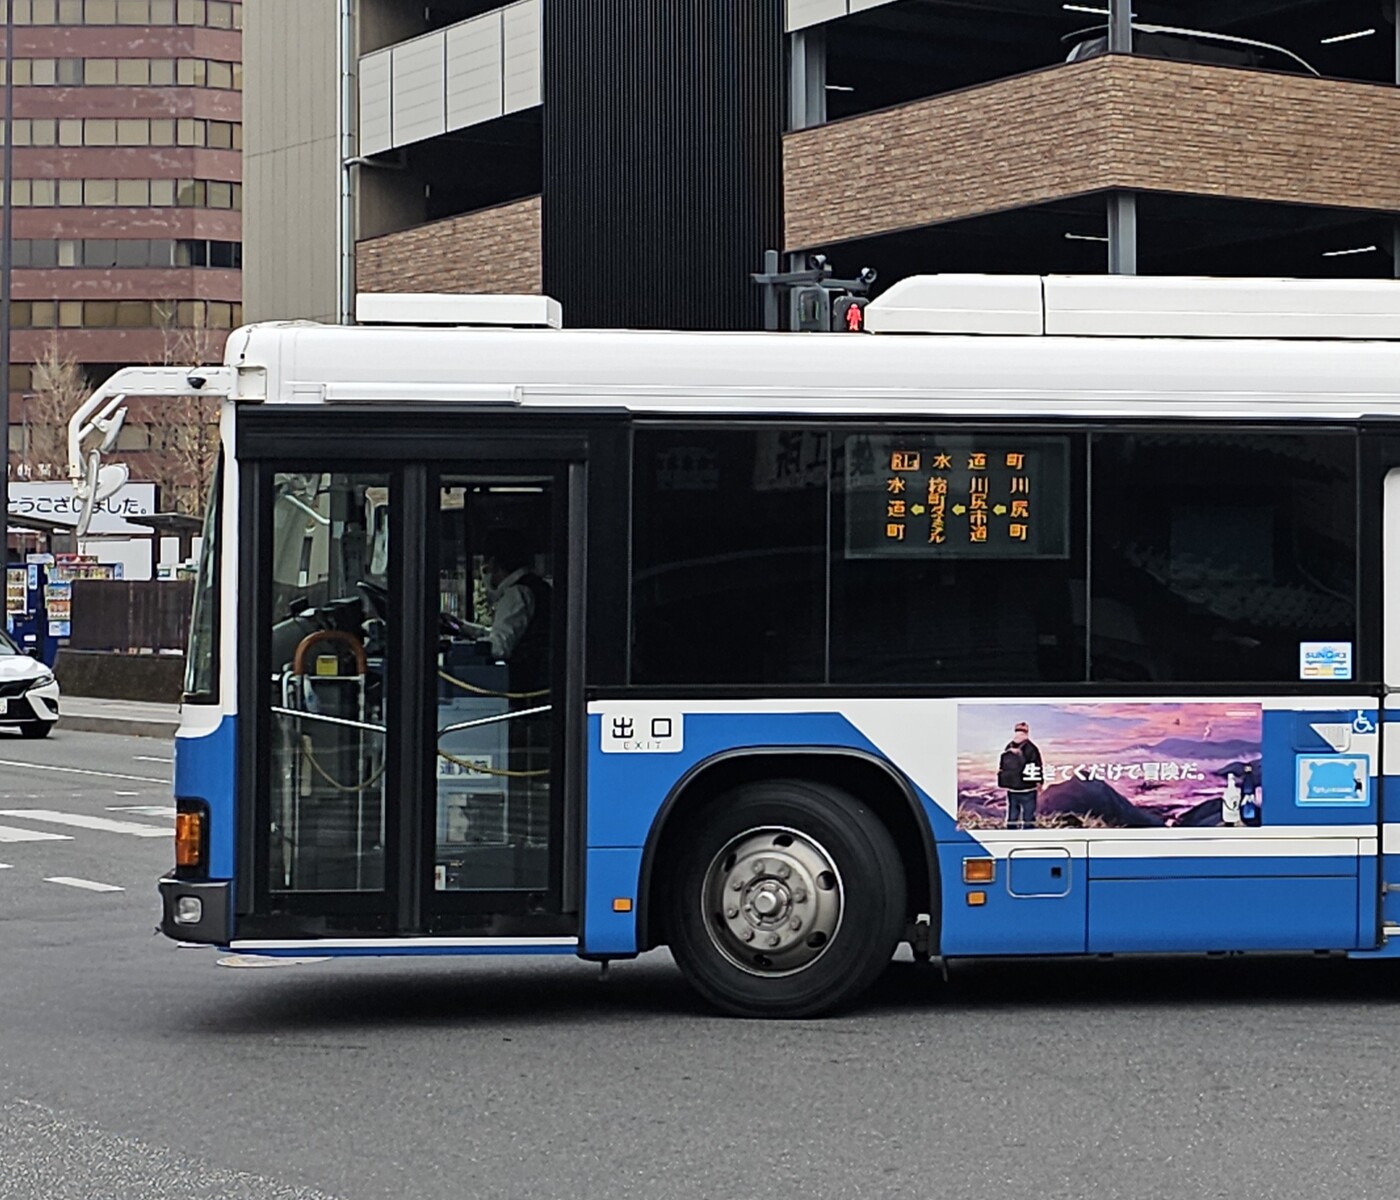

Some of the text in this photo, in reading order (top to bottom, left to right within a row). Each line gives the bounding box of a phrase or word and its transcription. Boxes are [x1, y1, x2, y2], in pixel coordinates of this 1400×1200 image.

[886, 476, 906, 541] 水道町
[1009, 476, 1030, 541] 川尻町
[612, 717, 672, 738] 出口
[623, 742, 662, 750] EXIT
[1022, 762, 1205, 781] 生きてくだけで冒険だ。
